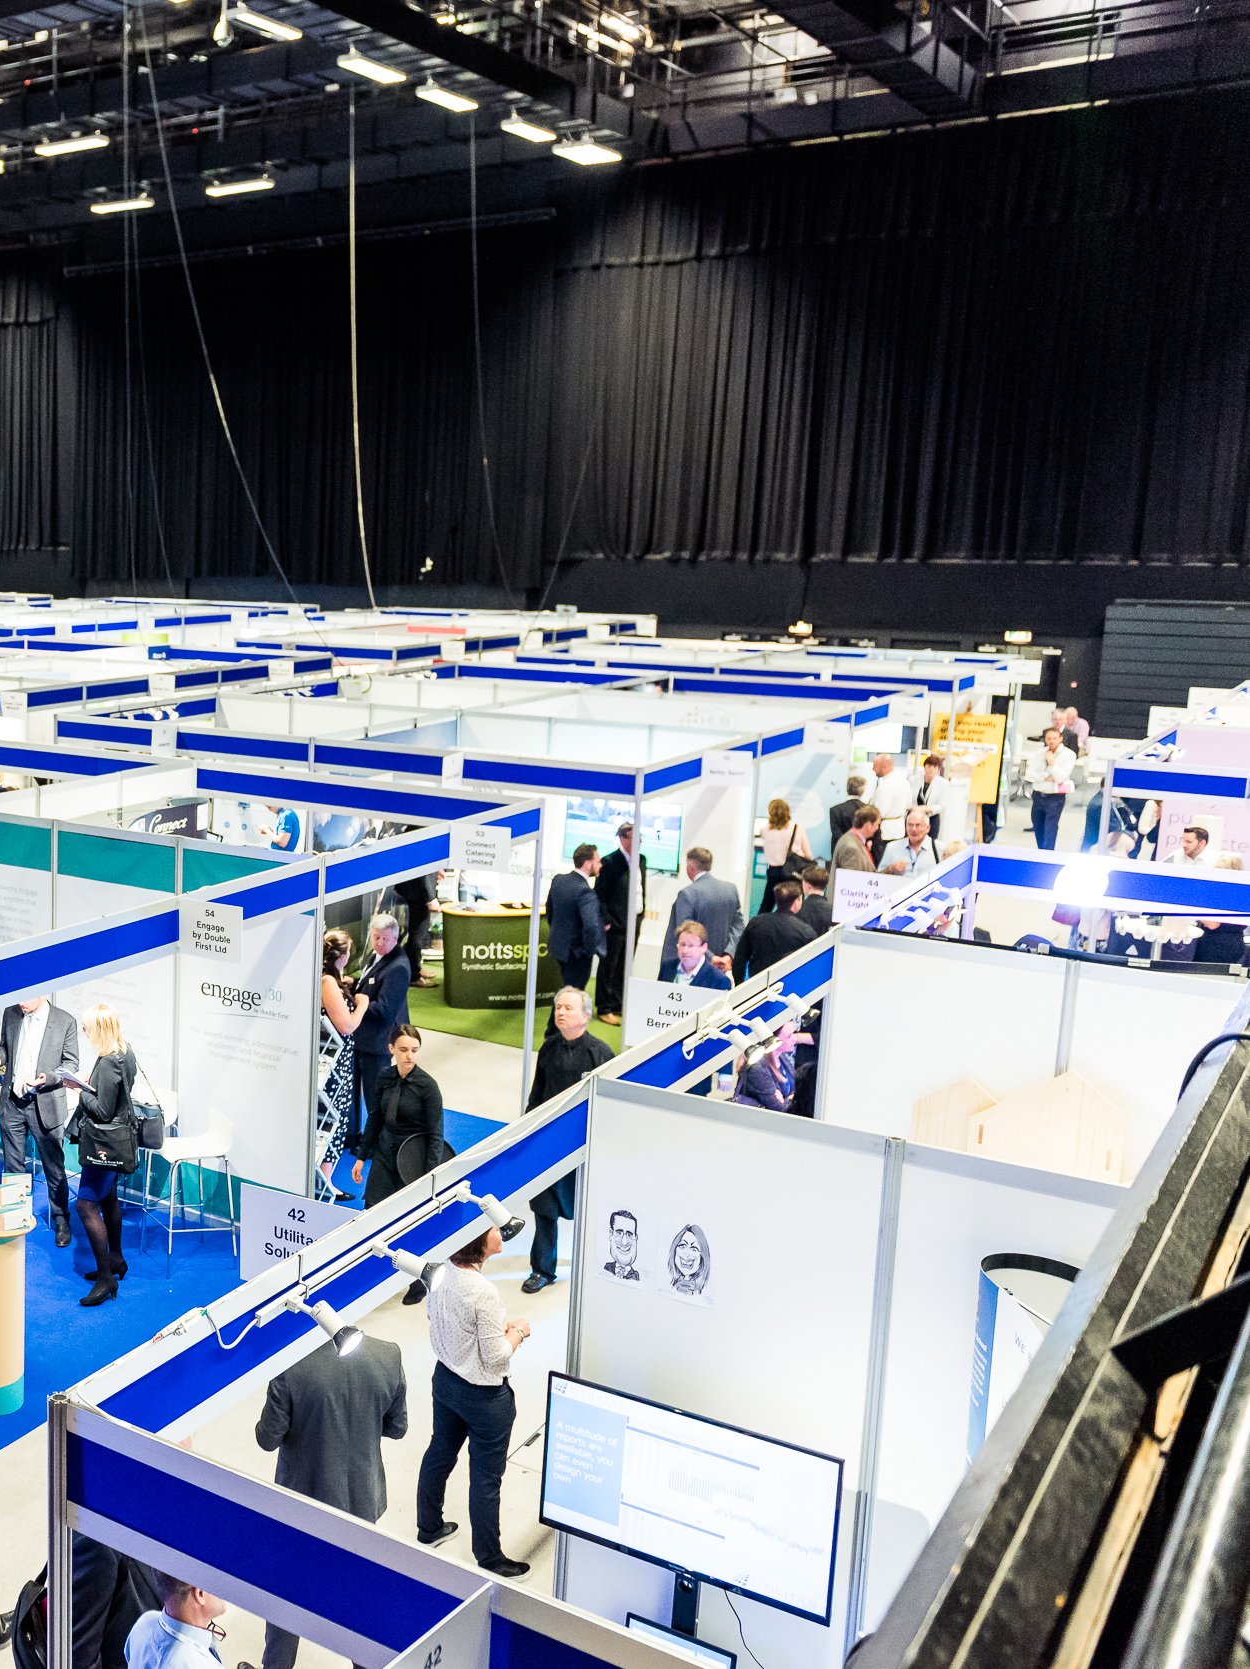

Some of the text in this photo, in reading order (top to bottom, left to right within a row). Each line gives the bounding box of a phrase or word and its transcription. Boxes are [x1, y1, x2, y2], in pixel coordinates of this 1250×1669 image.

[466, 840, 496, 849] Connect
[465, 850, 496, 858] Catering
[466, 858, 493, 866] Limited
[840, 888, 869, 900] Clarity
[204, 909, 215, 918] 54
[196, 920, 225, 934] Engage
[192, 930, 231, 944] by Double
[195, 942, 227, 954] First Ltd
[462, 962, 526, 972] Synthetic Surfacing
[200, 981, 262, 1012] engage
[668, 992, 682, 1002] 43
[287, 1208, 306, 1224] 42
[274, 1226, 318, 1246] Utilita
[556, 1432, 586, 1447] reports
[565, 1424, 606, 1443] multitude
[608, 1438, 618, 1446] of
[554, 1452, 593, 1470] can even
[597, 1455, 614, 1467] you
[553, 1472, 572, 1484] own
[554, 1461, 604, 1484] design your
[424, 1644, 442, 1669] 42
